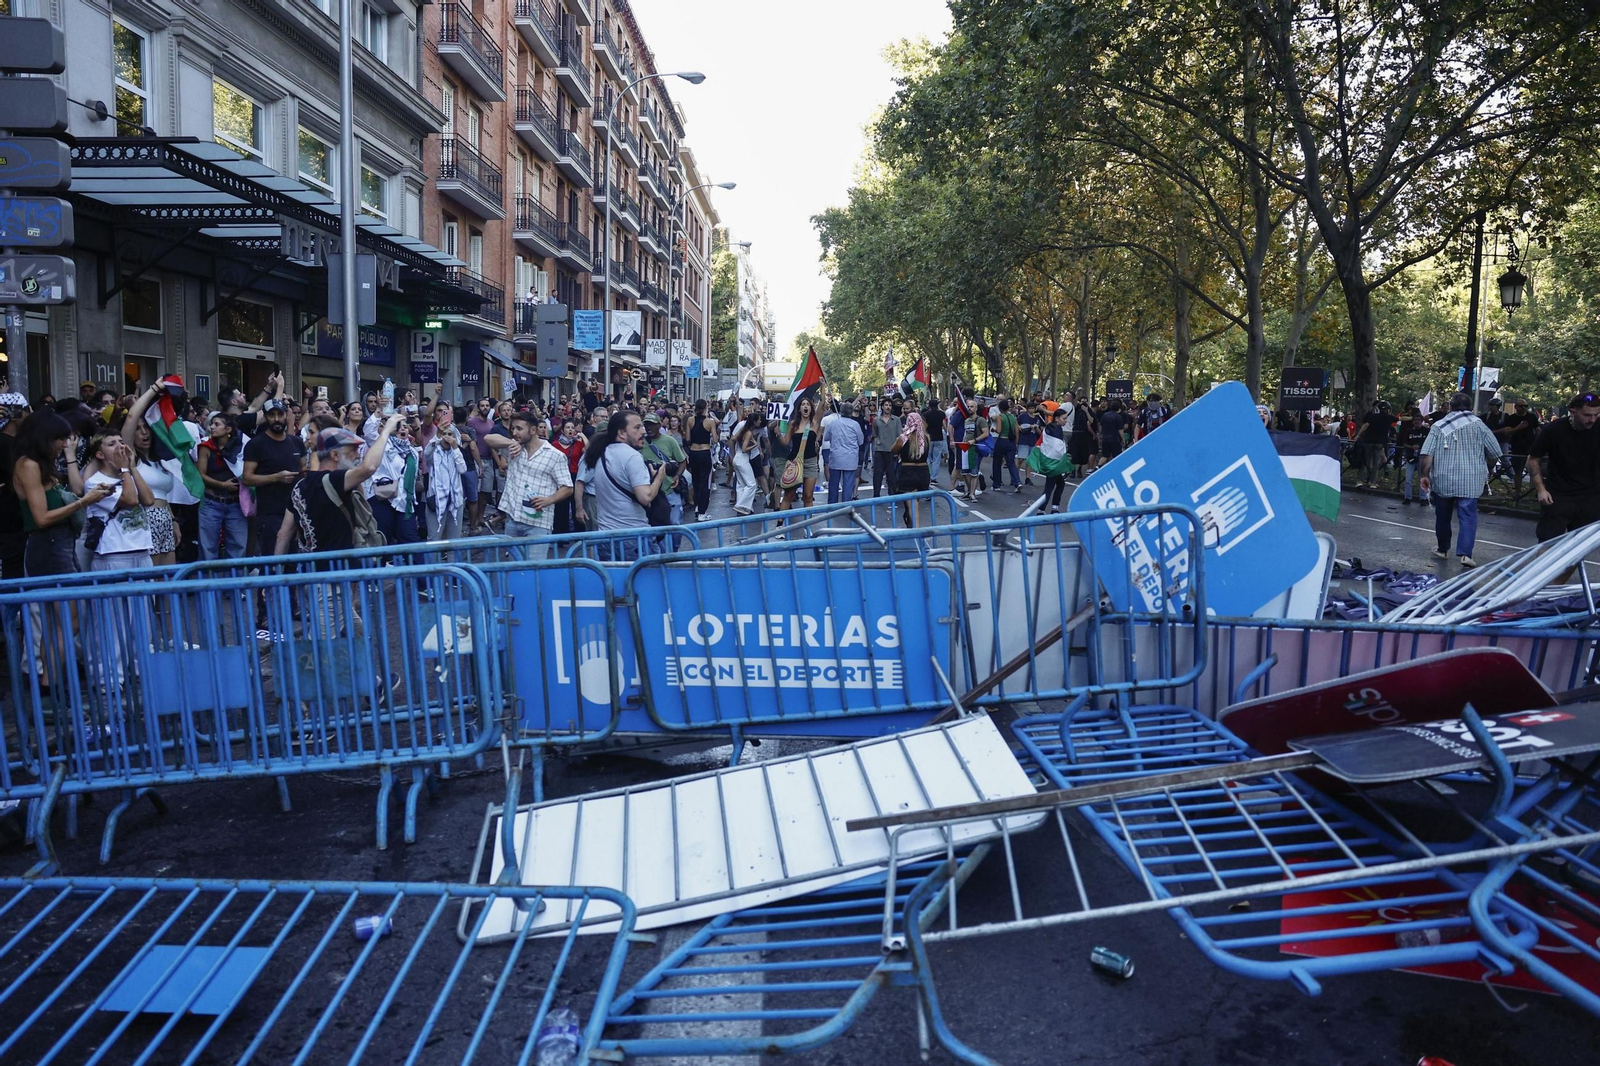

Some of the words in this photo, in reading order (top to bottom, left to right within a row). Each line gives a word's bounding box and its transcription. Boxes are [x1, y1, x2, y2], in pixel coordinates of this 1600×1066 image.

[360, 329, 389, 348] PÚBLICO
[1283, 387, 1321, 395] TISSOT
[767, 403, 790, 421] PAZ
[663, 607, 901, 648] LOTERÍAS
[684, 663, 735, 680] CON
[745, 665, 769, 681] EL
[779, 665, 884, 682] DEPORTE
